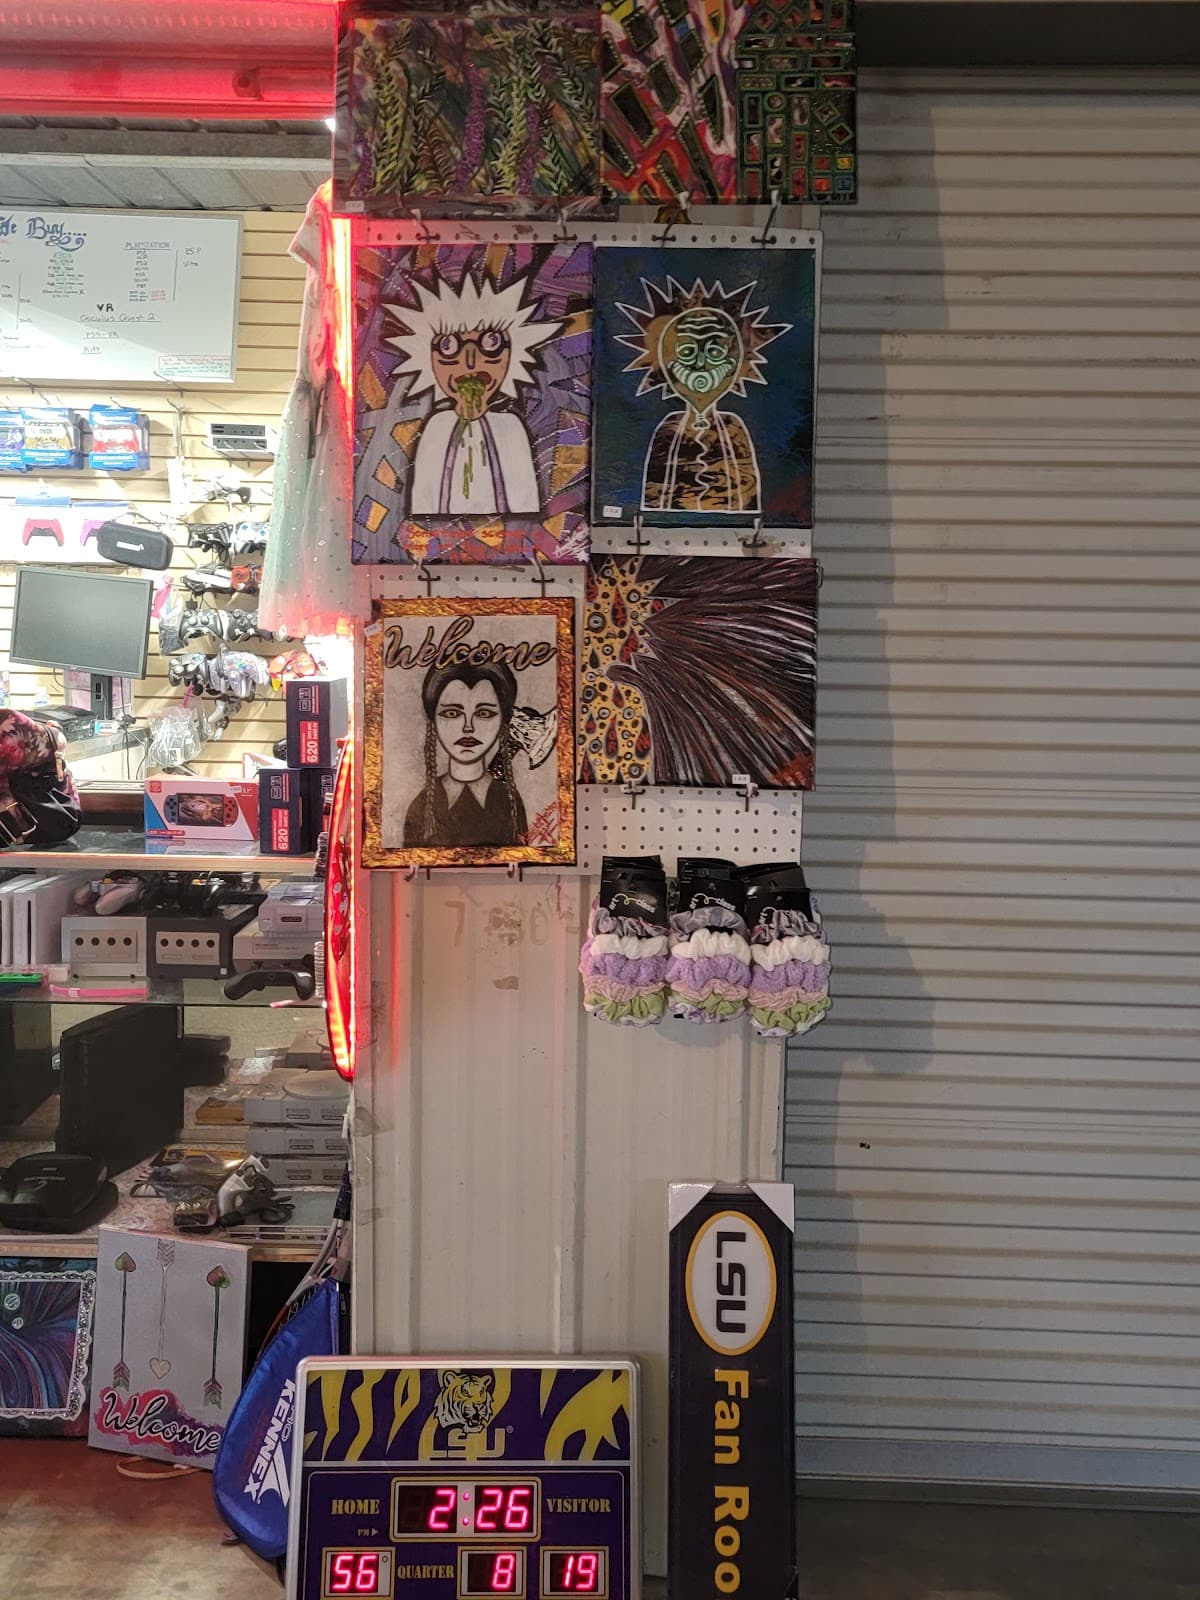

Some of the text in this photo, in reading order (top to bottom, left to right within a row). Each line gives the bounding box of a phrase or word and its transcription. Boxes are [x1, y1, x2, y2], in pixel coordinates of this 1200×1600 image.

[96, 302, 114, 313] VR
[147, 312, 156, 321] 2
[385, 615, 558, 672] Welcome
[307, 740, 318, 763] 620
[277, 828, 289, 850] 620
[715, 1231, 747, 1334] LSU
[102, 1389, 221, 1453] Welcome
[243, 1378, 295, 1503] KENNEX
[424, 1427, 506, 1459] LSU
[714, 1369, 750, 1595] Fan Roo
[331, 1499, 381, 1515] HOME
[428, 1488, 532, 1530] 2:26
[546, 1498, 612, 1514] VISITOR
[331, 1554, 379, 1591] 56
[397, 1564, 455, 1580] QUARTER
[490, 1553, 517, 1590] 8
[562, 1553, 599, 1590] 19
